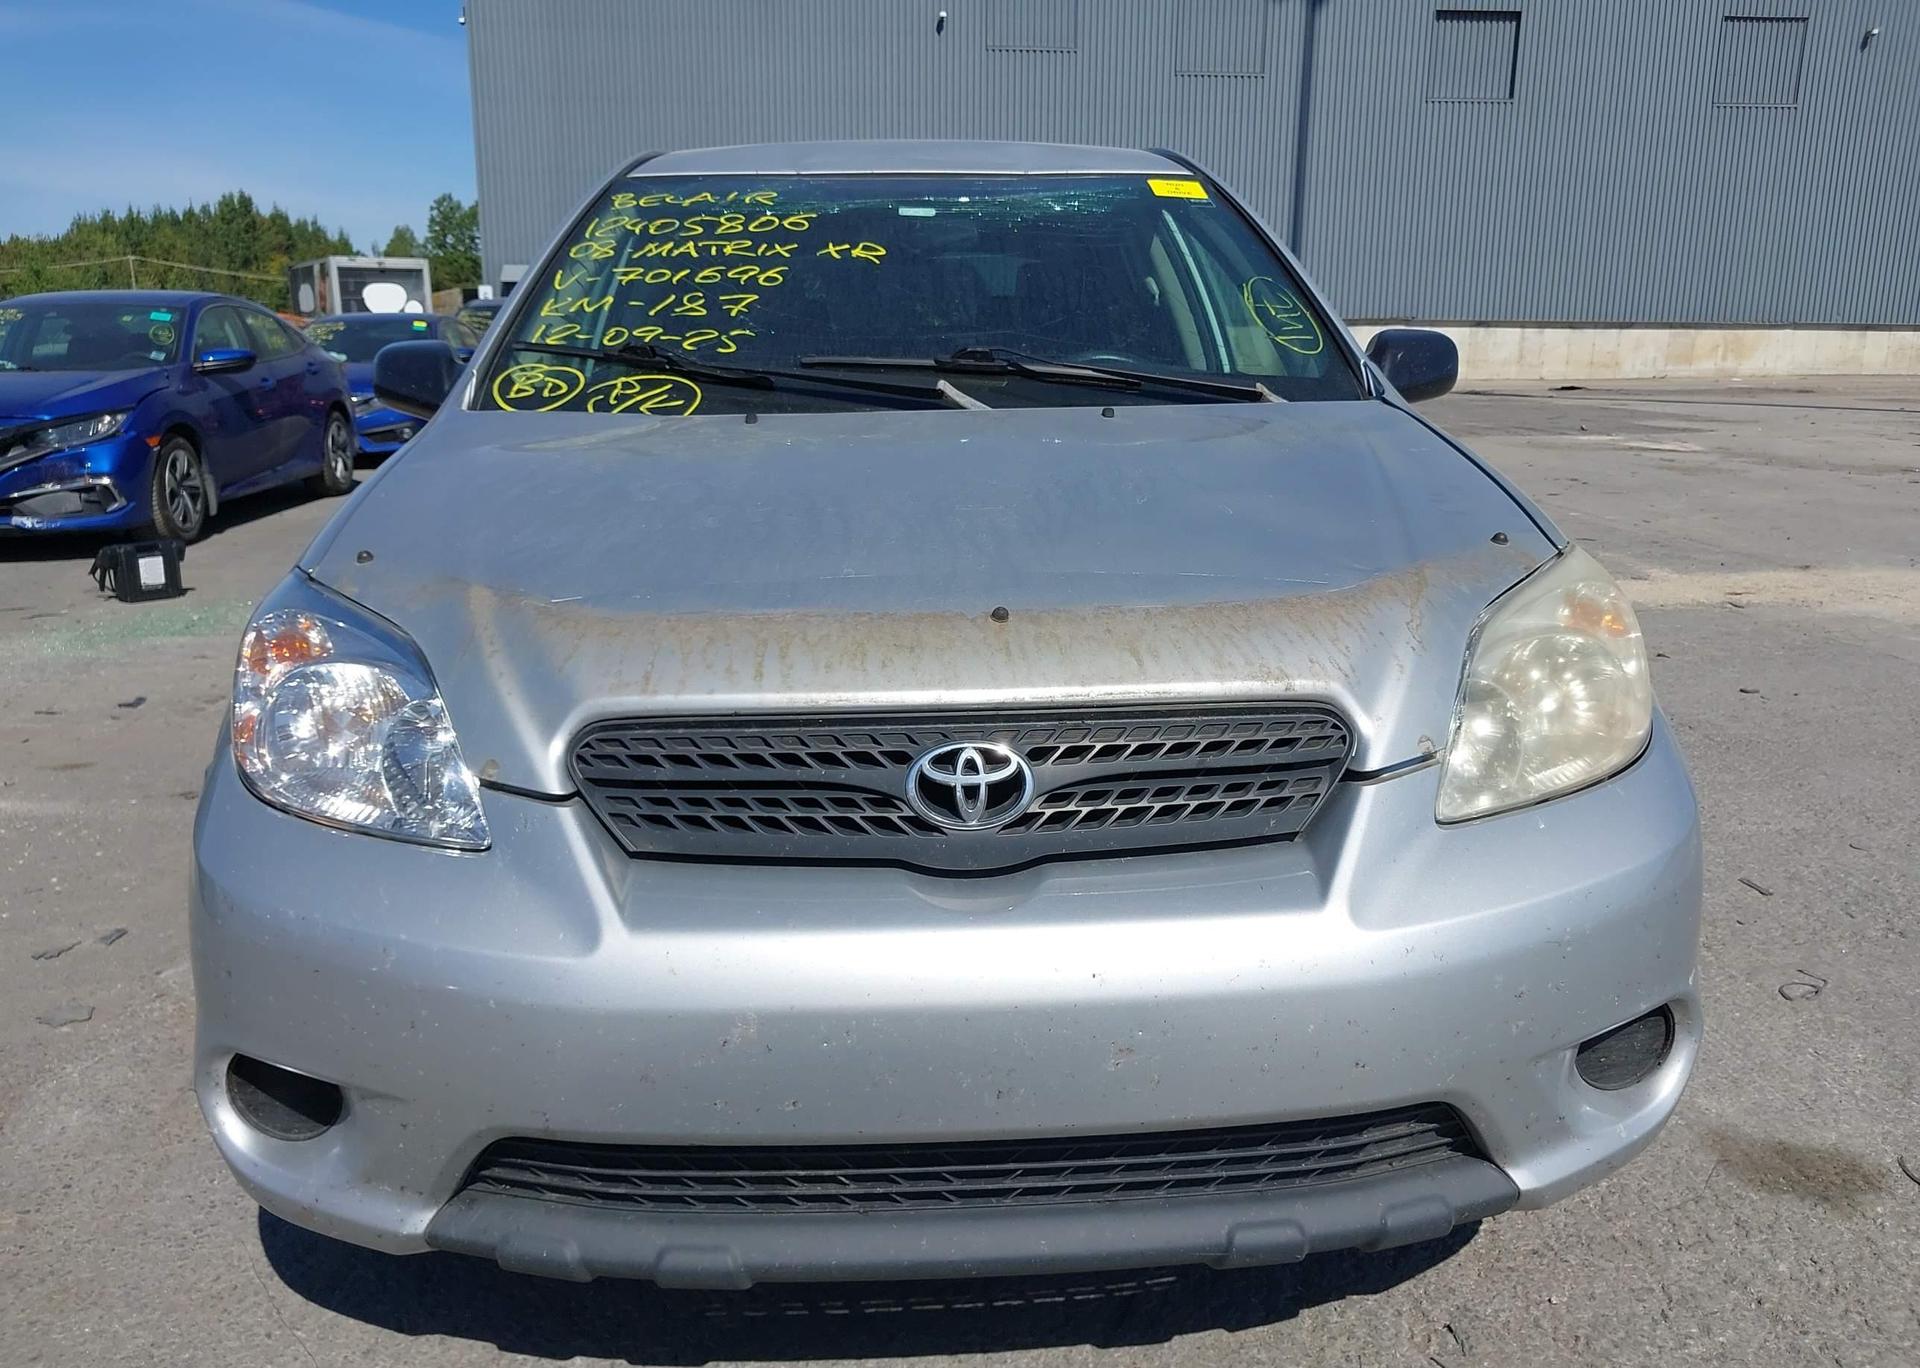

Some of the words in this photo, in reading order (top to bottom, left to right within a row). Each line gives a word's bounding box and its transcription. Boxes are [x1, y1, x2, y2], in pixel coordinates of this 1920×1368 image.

[611, 191, 778, 210] BELAIR
[569, 239, 617, 259] 08
[631, 240, 799, 259] MATRIX
[816, 241, 887, 264] XR
[506, 371, 569, 399] BD
